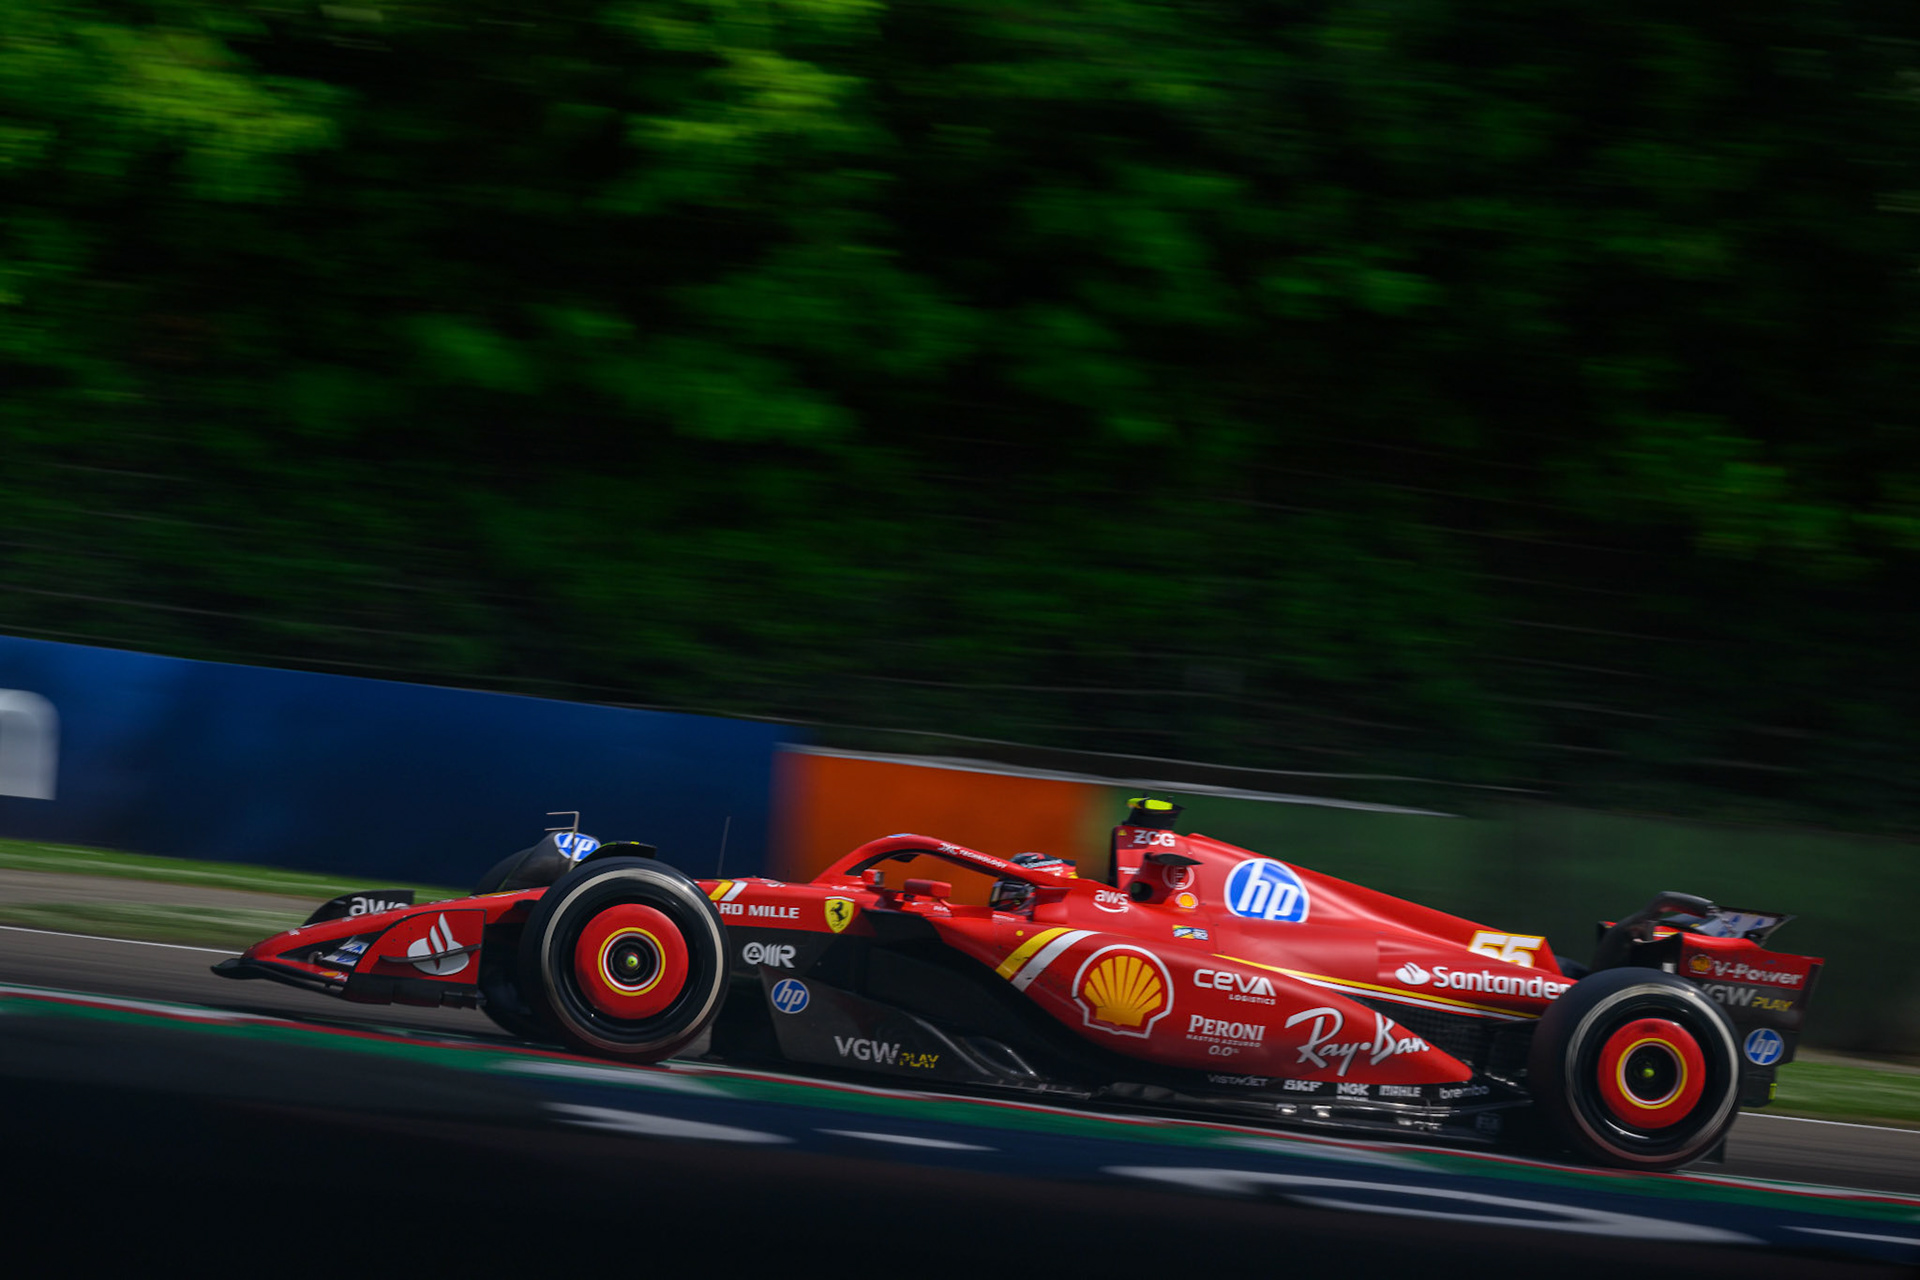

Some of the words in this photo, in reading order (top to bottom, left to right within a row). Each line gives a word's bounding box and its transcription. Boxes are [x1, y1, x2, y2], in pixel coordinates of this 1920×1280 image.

[559, 833, 597, 861] hp
[1133, 829, 1176, 847] ZCG
[1094, 889, 1129, 905] aws
[1235, 860, 1301, 921] hp
[748, 904, 800, 919] MILLE
[1467, 930, 1546, 968] 55
[1432, 966, 1572, 1000] Santander
[1713, 960, 1804, 985] V-Power
[776, 980, 807, 1013] hp
[1229, 993, 1276, 1006] LOGISTICS
[1751, 997, 1794, 1012] PLAY
[1187, 1014, 1266, 1041] PERONI
[834, 1036, 900, 1065] VGW
[899, 1053, 940, 1068] PLAY
[1749, 1029, 1781, 1065] hp
[1283, 1080, 1323, 1092] SKF
[1336, 1082, 1369, 1096] NGK
[1379, 1085, 1422, 1097] MAHLE
[1439, 1084, 1489, 1099] brembo
